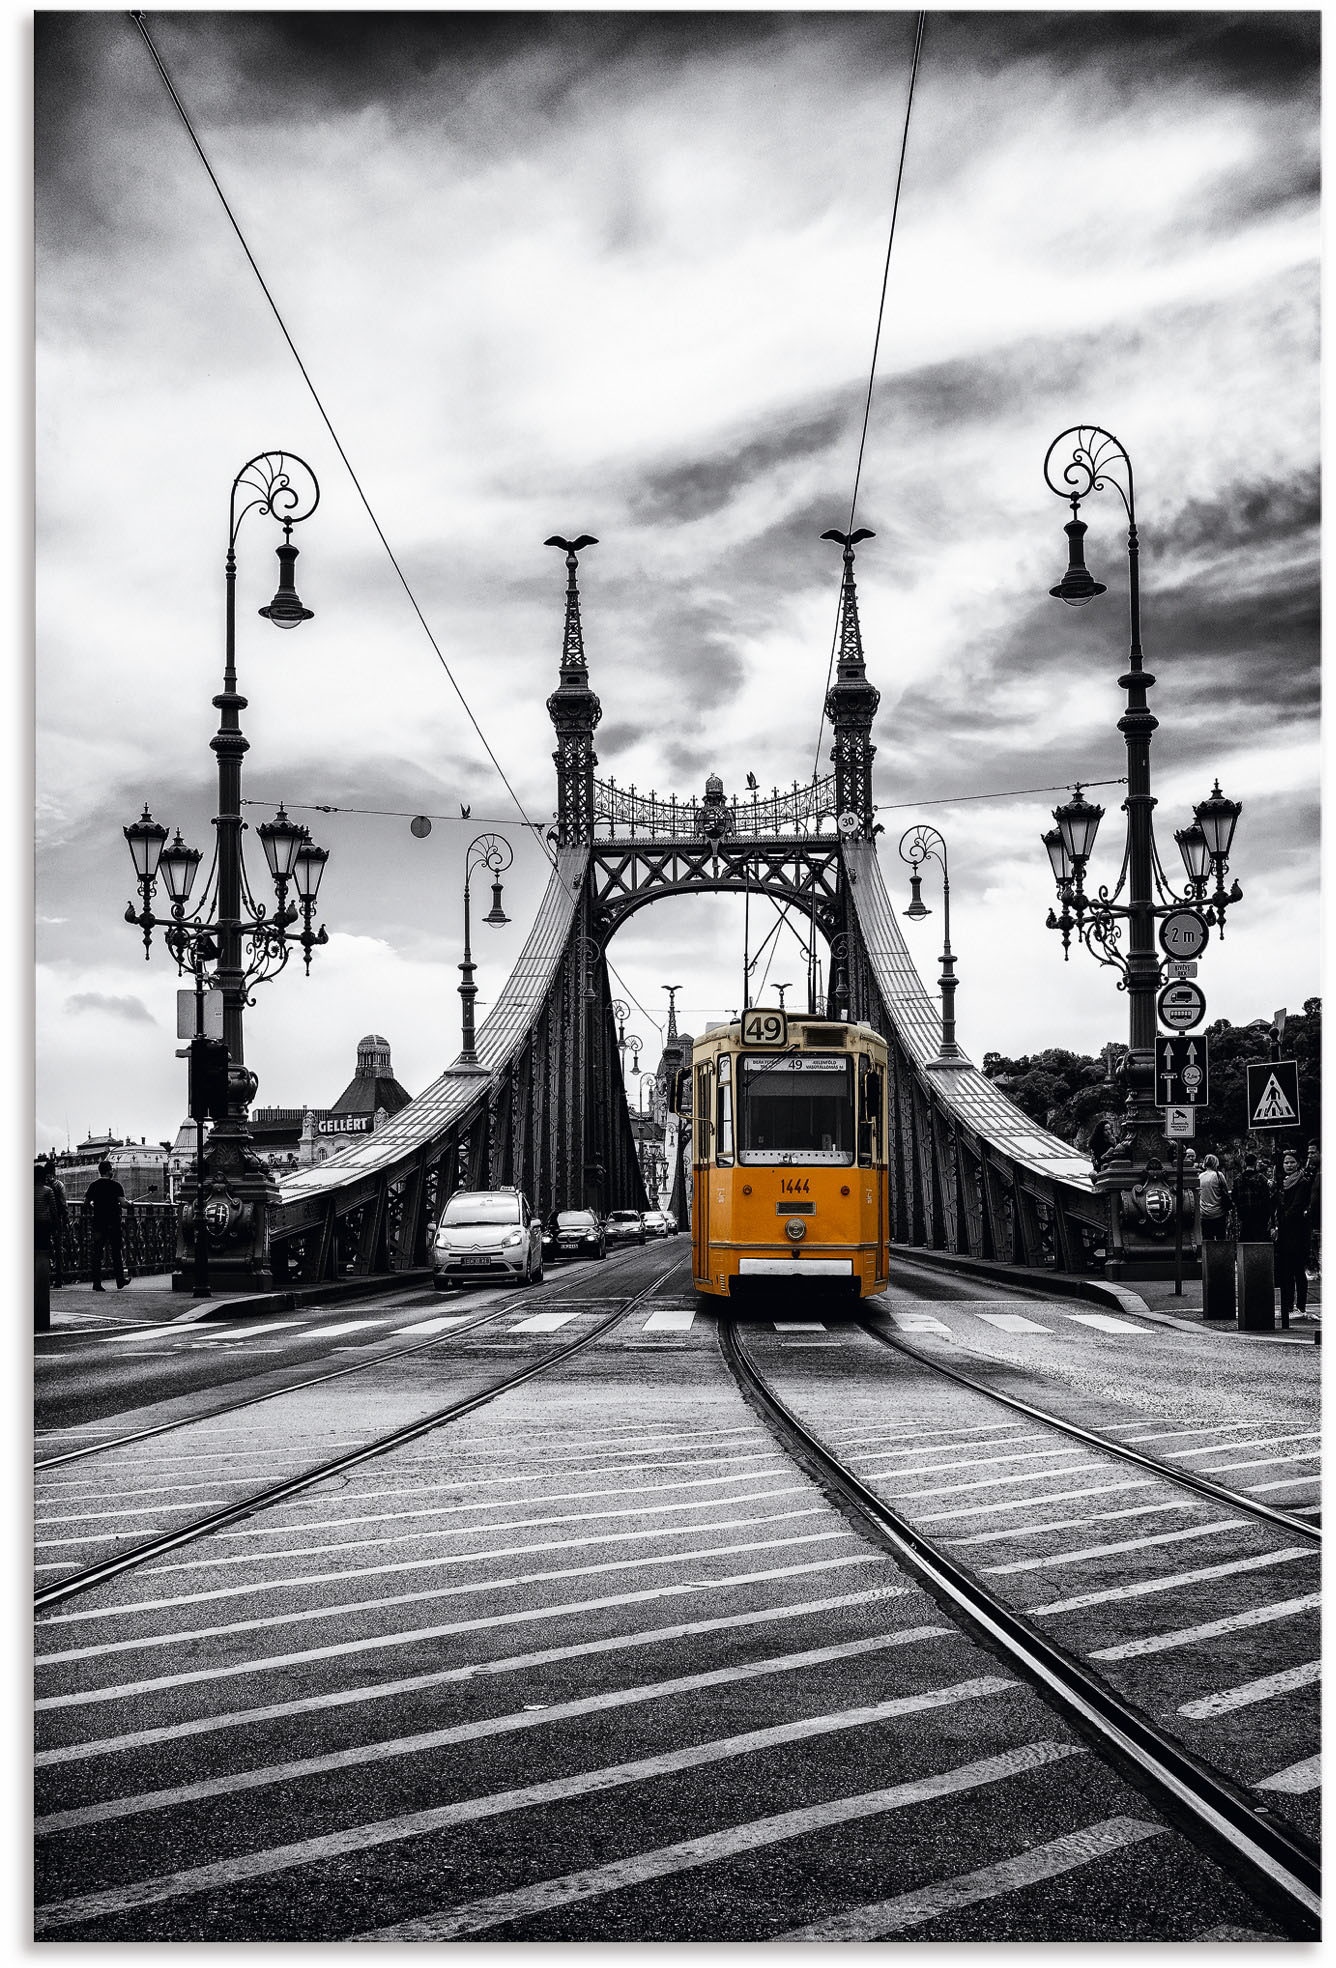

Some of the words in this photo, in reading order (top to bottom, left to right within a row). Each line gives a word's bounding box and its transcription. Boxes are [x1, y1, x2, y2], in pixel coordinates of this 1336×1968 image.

[842, 817, 854, 827] 30
[1171, 927, 1179, 943] 2
[1183, 931, 1195, 943] m
[746, 1016, 782, 1041] 49
[788, 1059, 803, 1070] 49
[318, 1115, 368, 1133] GELLÉRT
[781, 1178, 810, 1194] 1444
